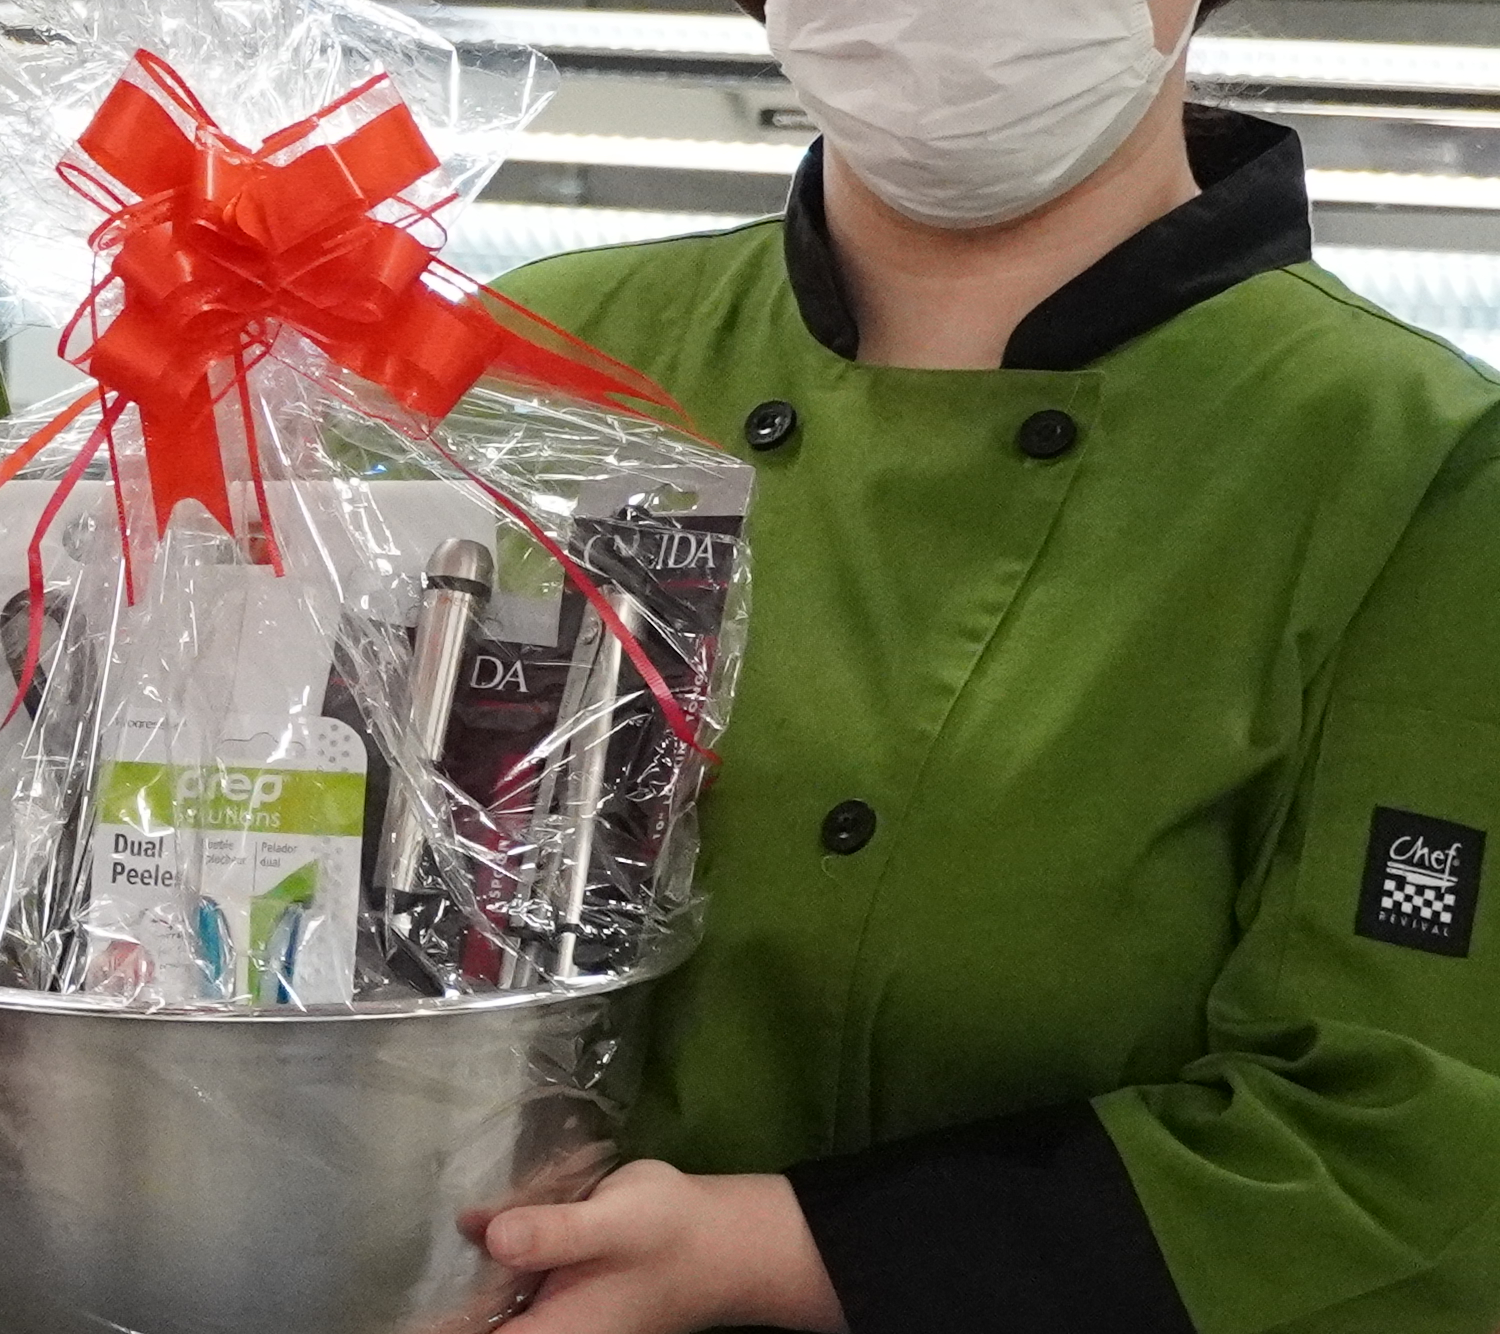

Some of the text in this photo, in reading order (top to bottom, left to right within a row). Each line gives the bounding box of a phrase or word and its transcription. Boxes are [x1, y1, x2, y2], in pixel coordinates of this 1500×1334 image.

[177, 770, 283, 809] prep
[113, 832, 164, 859] Dual
[261, 841, 298, 853] Pelador
[1389, 836, 1463, 877] Chef
[111, 862, 177, 886] Peele
[1378, 910, 1450, 937] REVIVAL
